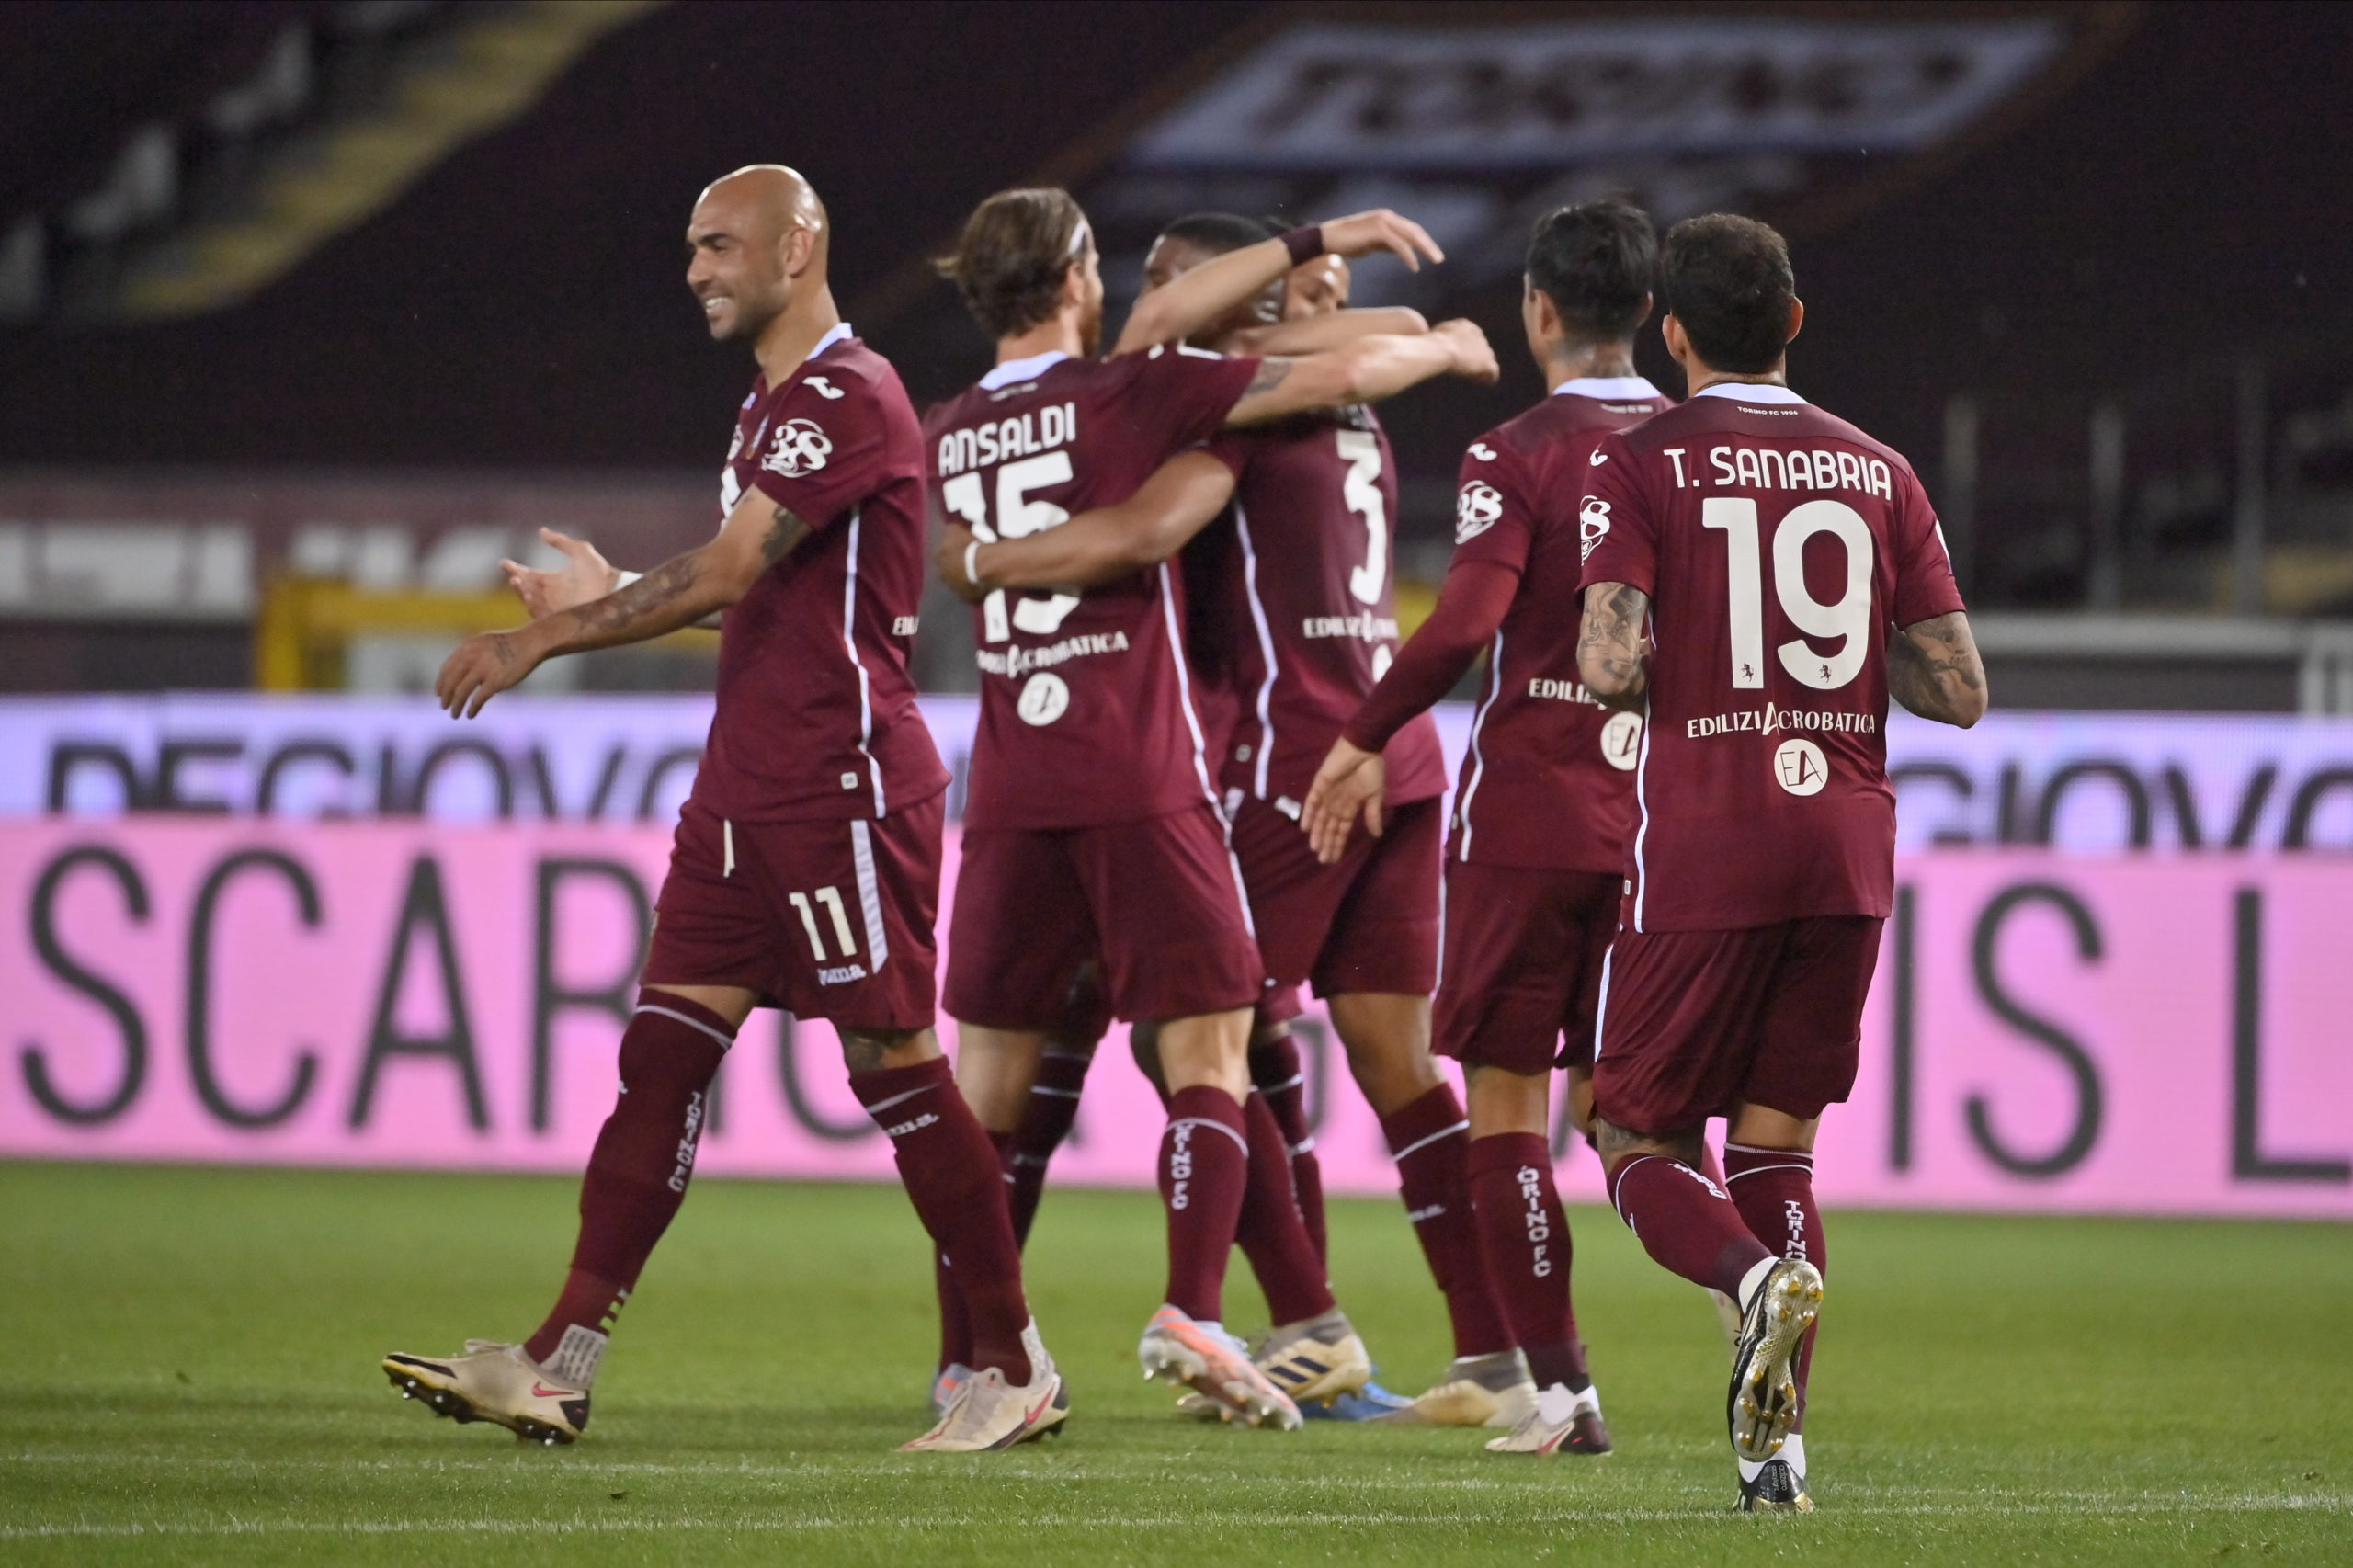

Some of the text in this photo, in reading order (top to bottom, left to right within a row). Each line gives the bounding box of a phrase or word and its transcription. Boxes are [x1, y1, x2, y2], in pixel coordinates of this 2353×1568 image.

[938, 401, 1076, 478] ANSALDI
[1736, 405, 1768, 415] TORINO
[1336, 429, 1387, 605] 3
[1663, 446, 1891, 500] T. SANABRIA
[943, 449, 1079, 643] 15
[1702, 497, 1873, 689] 19
[788, 885, 858, 962] 11
[1516, 1165, 1552, 1278] ORINO FC
